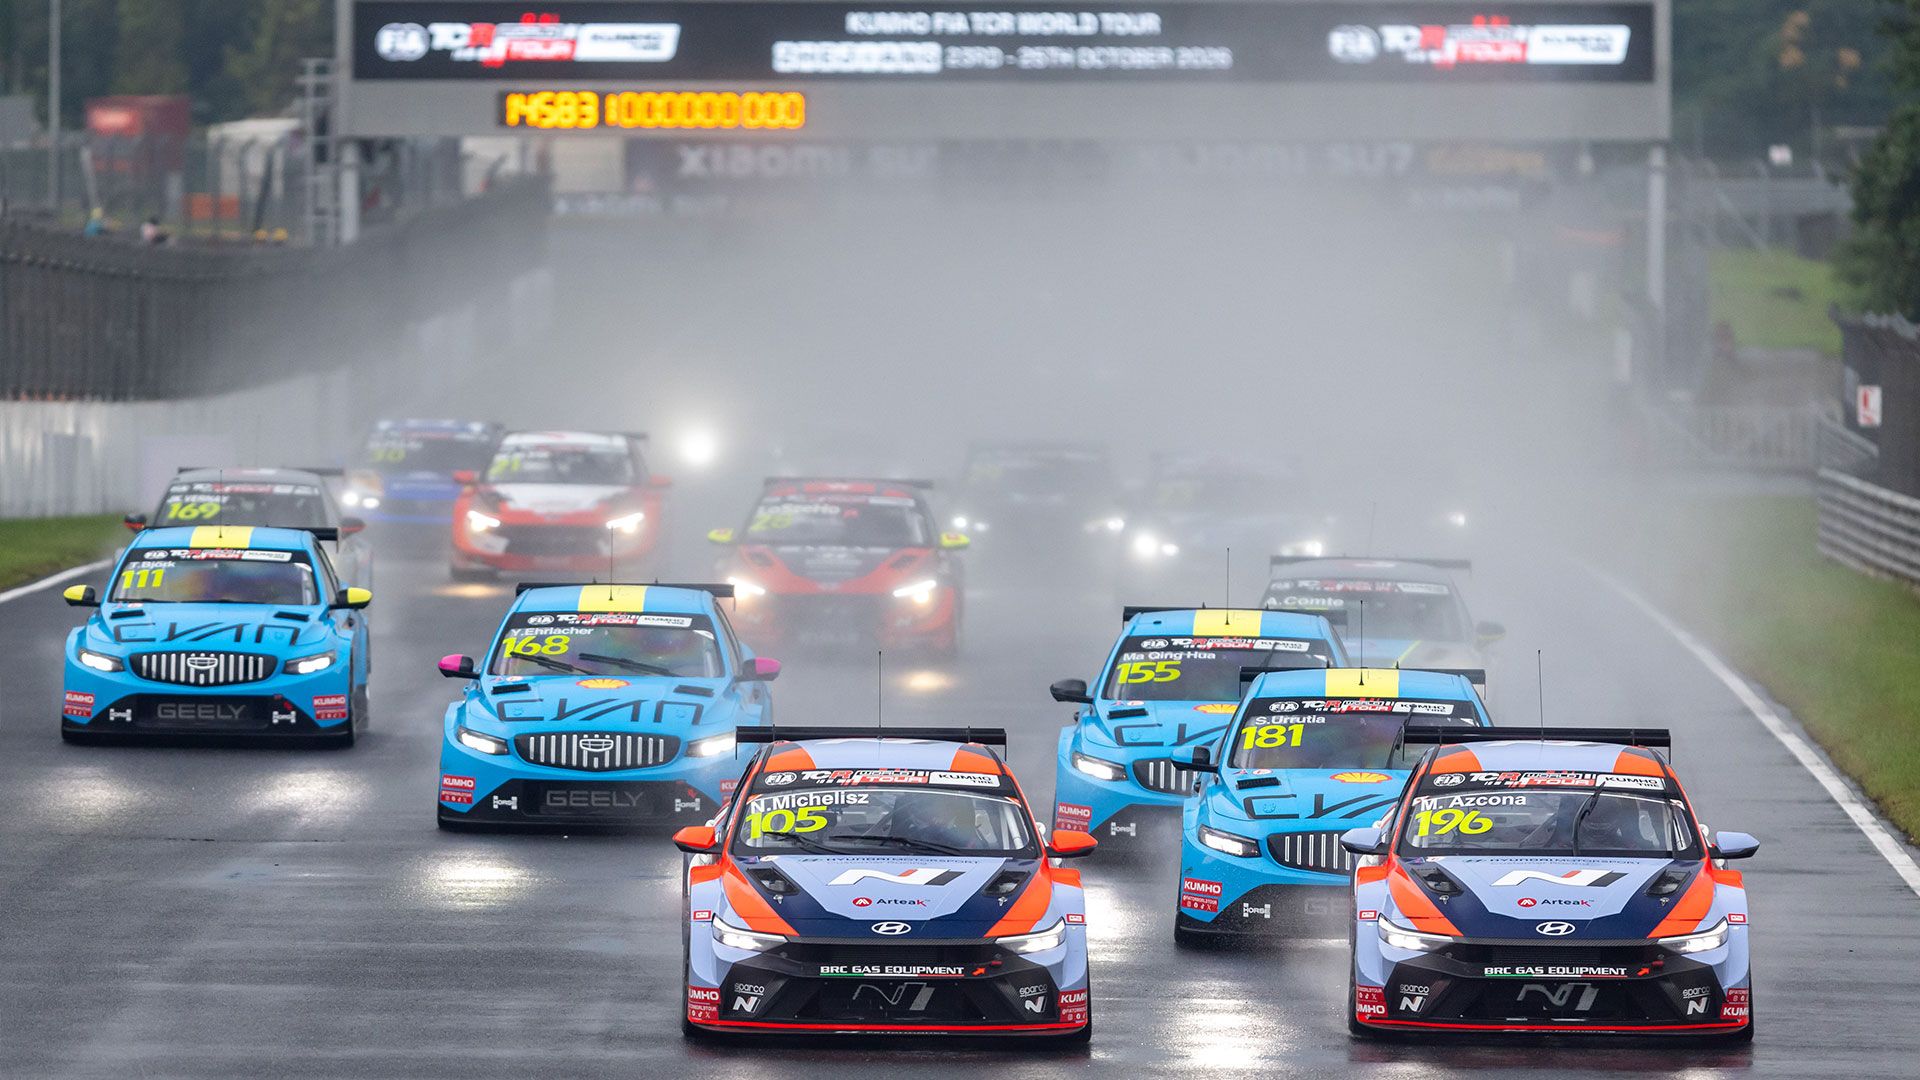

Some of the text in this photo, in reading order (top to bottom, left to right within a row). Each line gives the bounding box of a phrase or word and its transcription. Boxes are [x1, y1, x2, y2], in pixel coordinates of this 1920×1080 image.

[845, 12, 931, 35] KUMHO
[1017, 12, 1098, 35] WORLD
[1100, 12, 1162, 35] TOUR
[168, 501, 221, 519] 169
[129, 561, 176, 570] T.Björk
[121, 569, 165, 589] 111
[1265, 595, 1345, 607] A.Comte
[530, 616, 554, 624] FIA
[557, 614, 592, 622] TCR
[510, 626, 594, 637] Y.Ehrlacher
[502, 635, 571, 659] 168
[1143, 640, 1167, 648] FIA
[1171, 638, 1207, 646] TCR
[1122, 651, 1216, 662] Ma Qing Hua
[1117, 660, 1182, 684] 155
[157, 703, 247, 719] GEELY
[1271, 702, 1298, 711] FIA
[1301, 700, 1343, 710] TCR
[1254, 714, 1326, 725] S.Urrutia
[1241, 724, 1305, 750] 181
[767, 773, 795, 785] FIA
[800, 770, 854, 781] TCR
[938, 773, 992, 782] KUMHO
[1435, 774, 1464, 786] FIA
[1470, 772, 1522, 782] TCR
[1605, 775, 1658, 784] KUMHO
[443, 777, 475, 788] KUMHO
[546, 790, 644, 806] GEELY
[750, 790, 870, 813] N.Michelisz
[1420, 795, 1528, 812] M. Azcona
[1058, 805, 1091, 817] KUMHO
[745, 806, 828, 839] 105
[1415, 808, 1494, 837] 196
[1184, 880, 1221, 894] KUMHO
[820, 965, 964, 975] BRC GAS EQUIPMENT
[1484, 966, 1627, 976] BRC GAS EQUIPMENT
[689, 988, 719, 1000] UMHO
[734, 982, 765, 995] sparco
[1019, 984, 1048, 996] sparco
[1400, 984, 1430, 995] sparco
[1357, 1003, 1385, 1014] MHO
